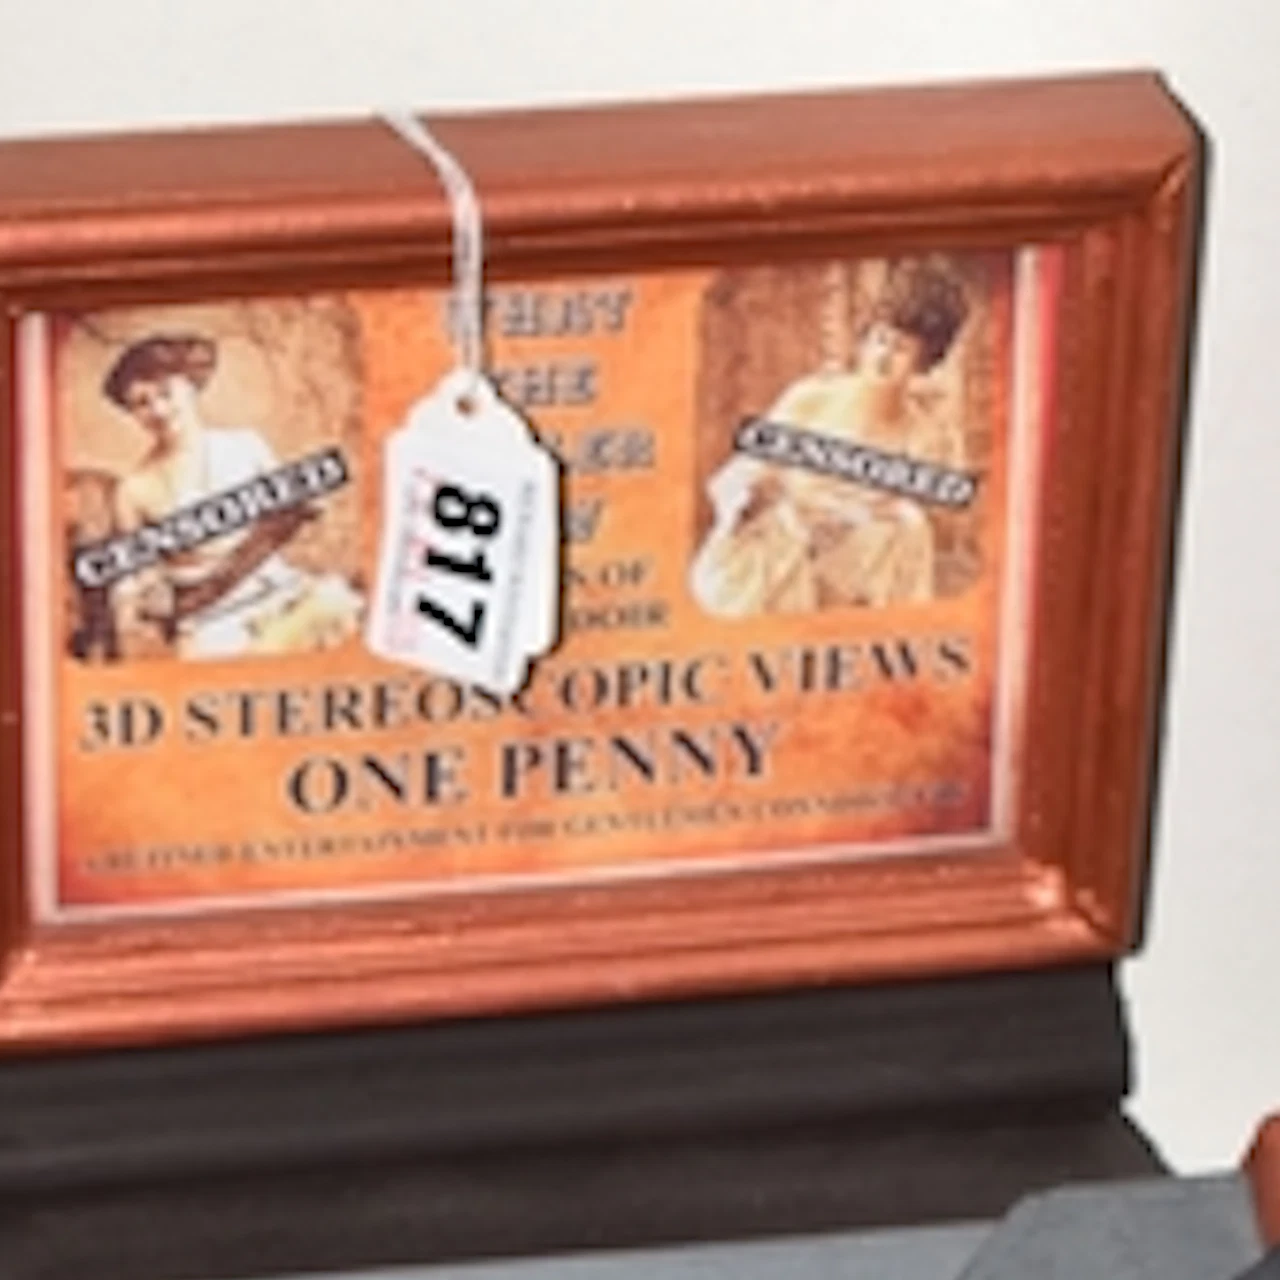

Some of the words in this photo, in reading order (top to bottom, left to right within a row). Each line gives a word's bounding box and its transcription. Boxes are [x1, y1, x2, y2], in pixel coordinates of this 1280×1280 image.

[735, 426, 975, 502] CENSORED
[76, 457, 344, 589] CENSORED
[416, 485, 501, 648] 817
[80, 694, 165, 752] 3D
[746, 638, 972, 693] VIEWS
[288, 747, 469, 813] ONE
[500, 722, 780, 798] PENNY
